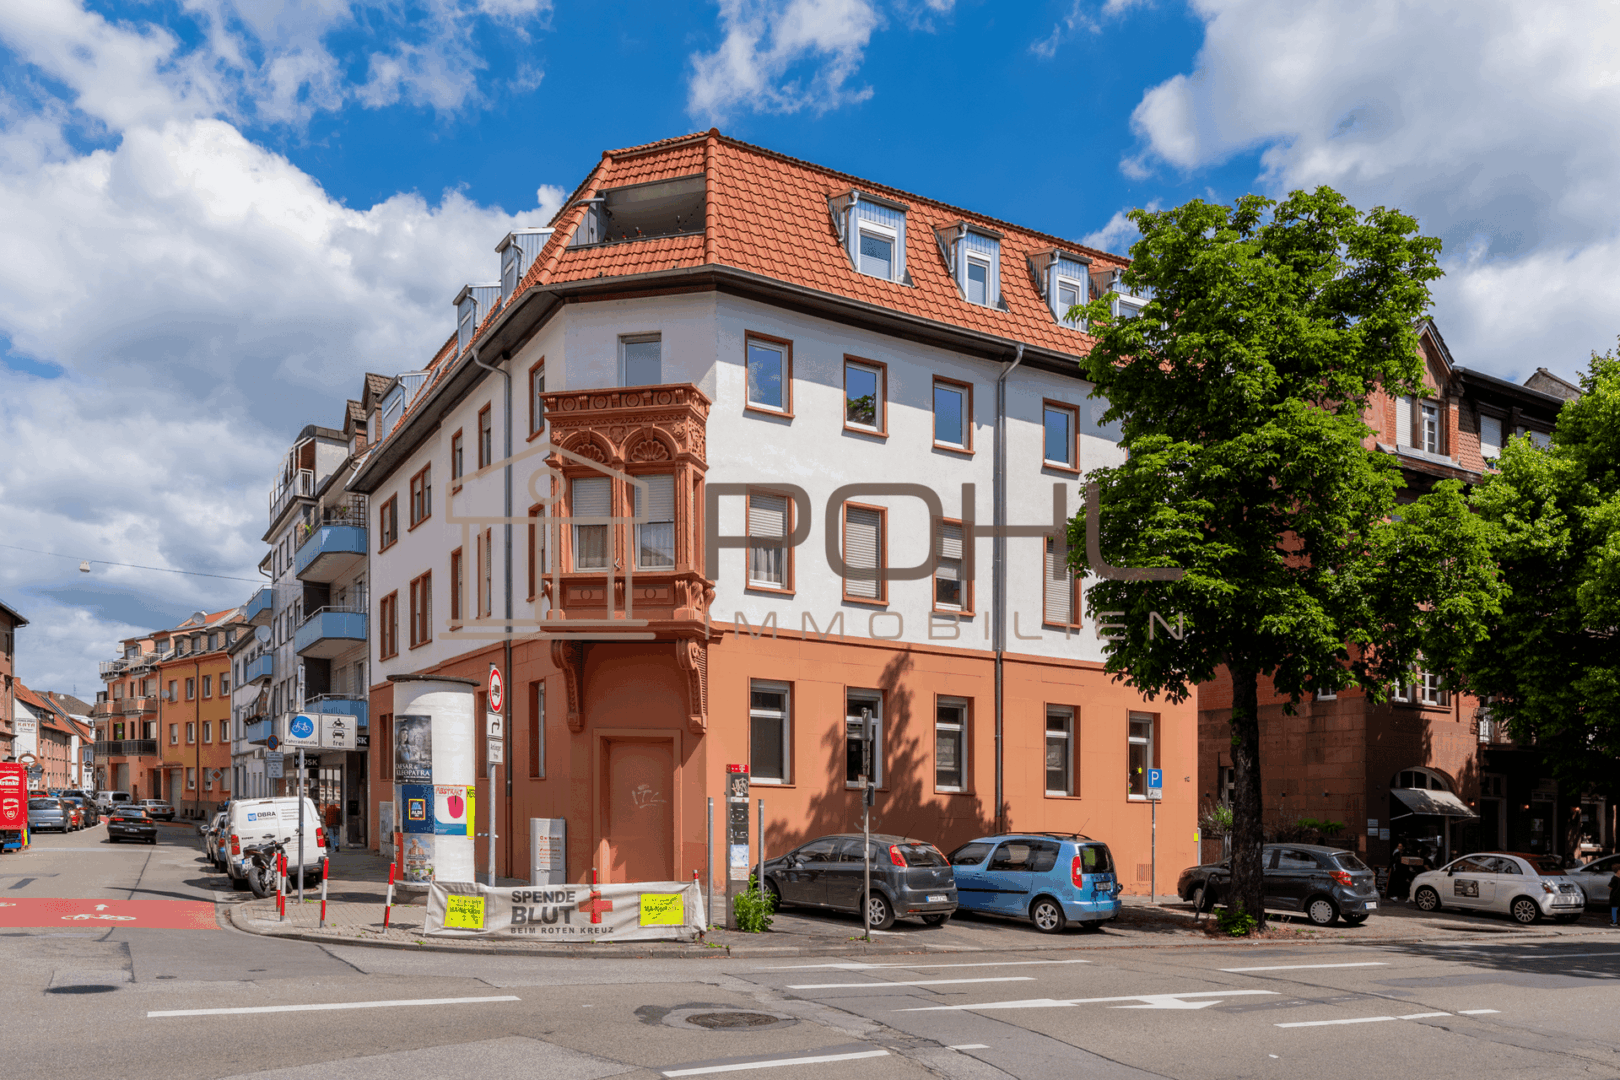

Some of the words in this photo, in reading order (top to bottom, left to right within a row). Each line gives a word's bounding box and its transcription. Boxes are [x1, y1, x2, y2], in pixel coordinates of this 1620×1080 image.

[295, 758, 318, 766] KOSK
[1151, 771, 1159, 785] P
[511, 890, 576, 904] SPENDE
[510, 905, 575, 925] BLUT
[580, 926, 614, 934] KREUZ
